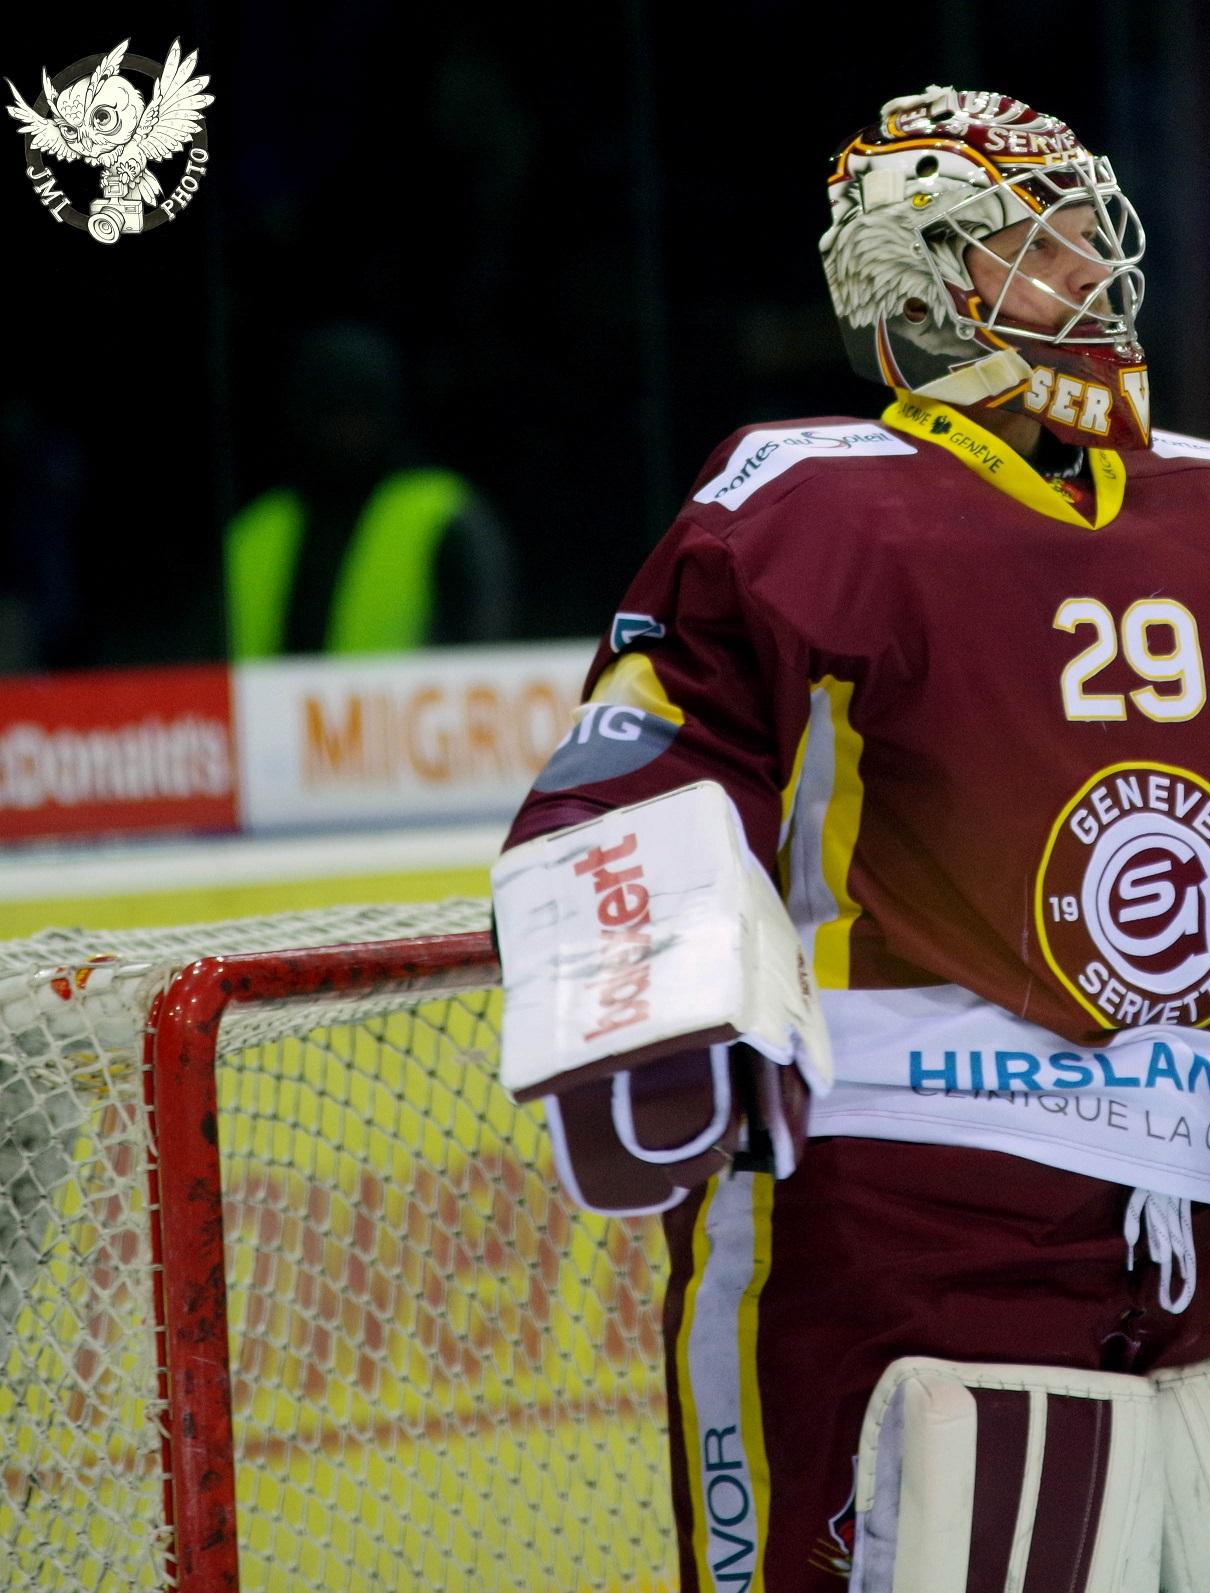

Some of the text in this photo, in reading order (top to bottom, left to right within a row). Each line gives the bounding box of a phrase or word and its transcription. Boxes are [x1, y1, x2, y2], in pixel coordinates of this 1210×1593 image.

[1052, 596, 1207, 723] 29
[0, 714, 228, 809] Donald's
[1049, 896, 1079, 922] 19
[1145, 1110, 1192, 1148] LA
